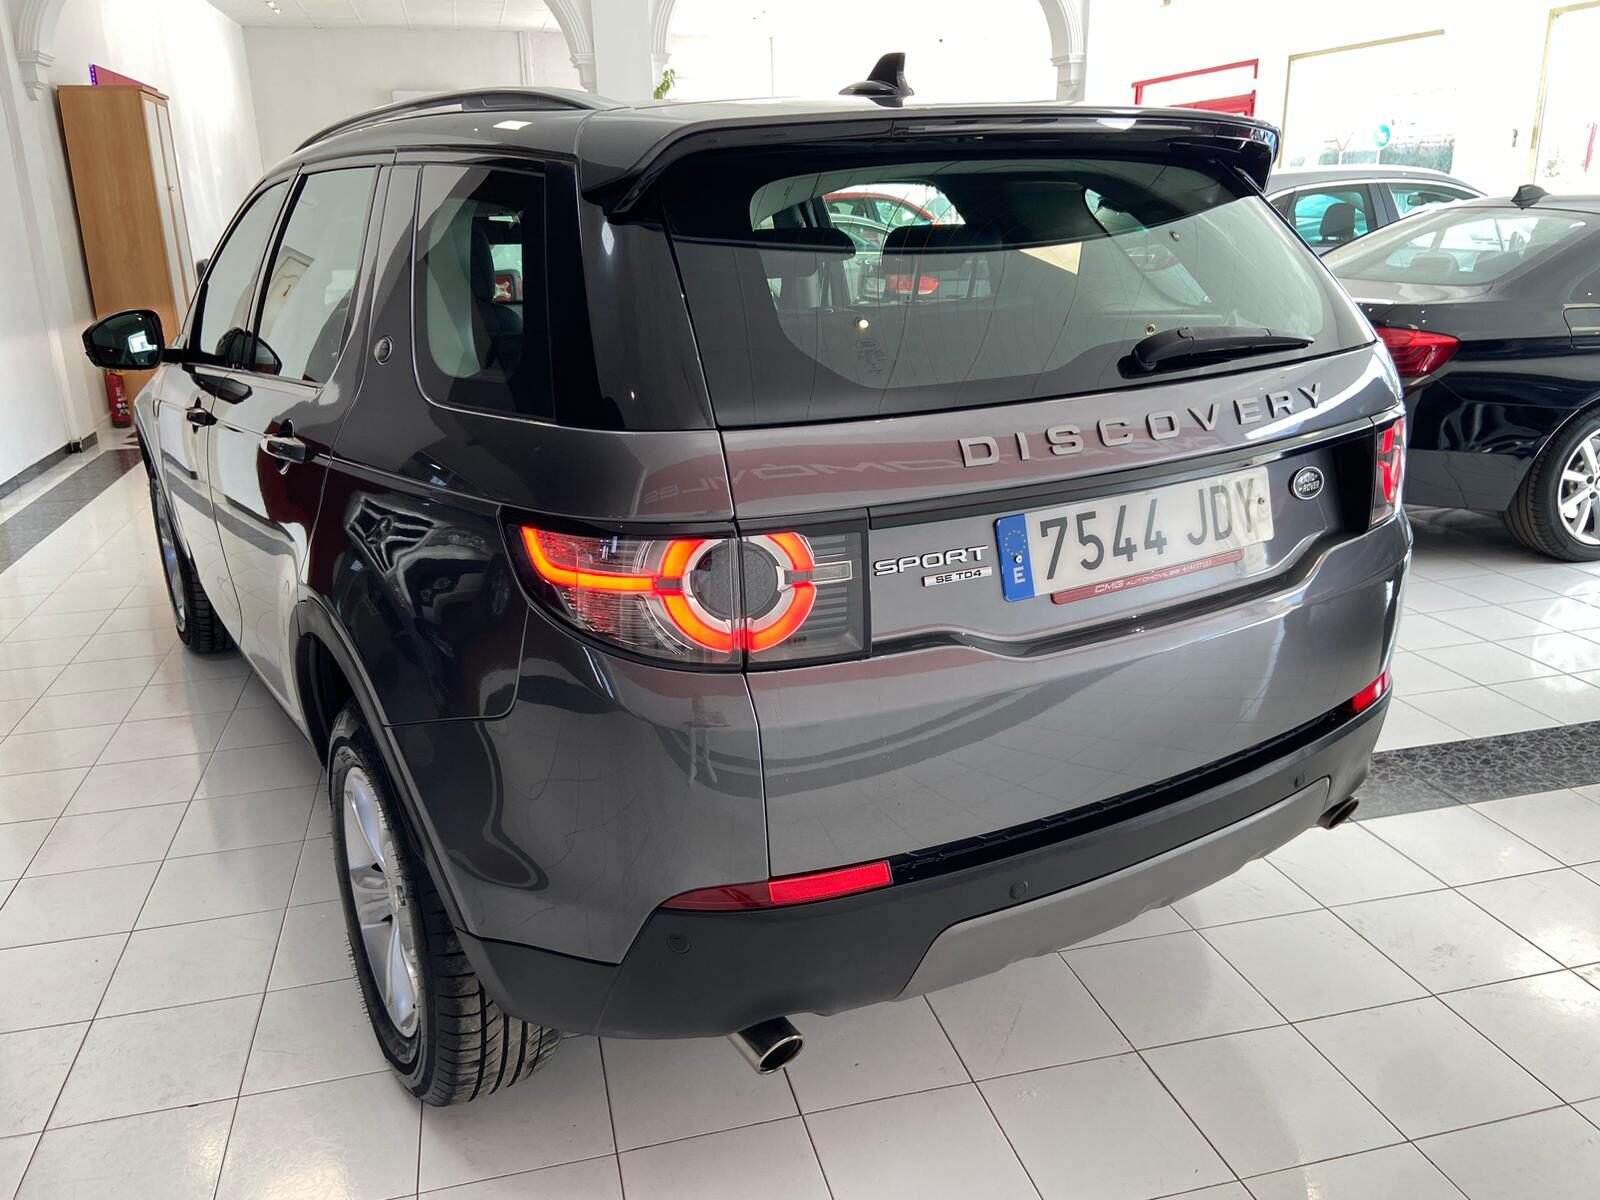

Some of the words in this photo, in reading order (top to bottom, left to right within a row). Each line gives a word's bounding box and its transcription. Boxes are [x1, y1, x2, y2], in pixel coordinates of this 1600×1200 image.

[958, 383, 1321, 467] DISCOVERY
[1040, 498, 1167, 580] 7544
[1187, 478, 1255, 546] JDY
[874, 545, 989, 576] SPORT
[935, 574, 953, 584] SE
[956, 569, 982, 580] TD4
[1013, 566, 1025, 584] E
[1094, 579, 1124, 593] CMG
